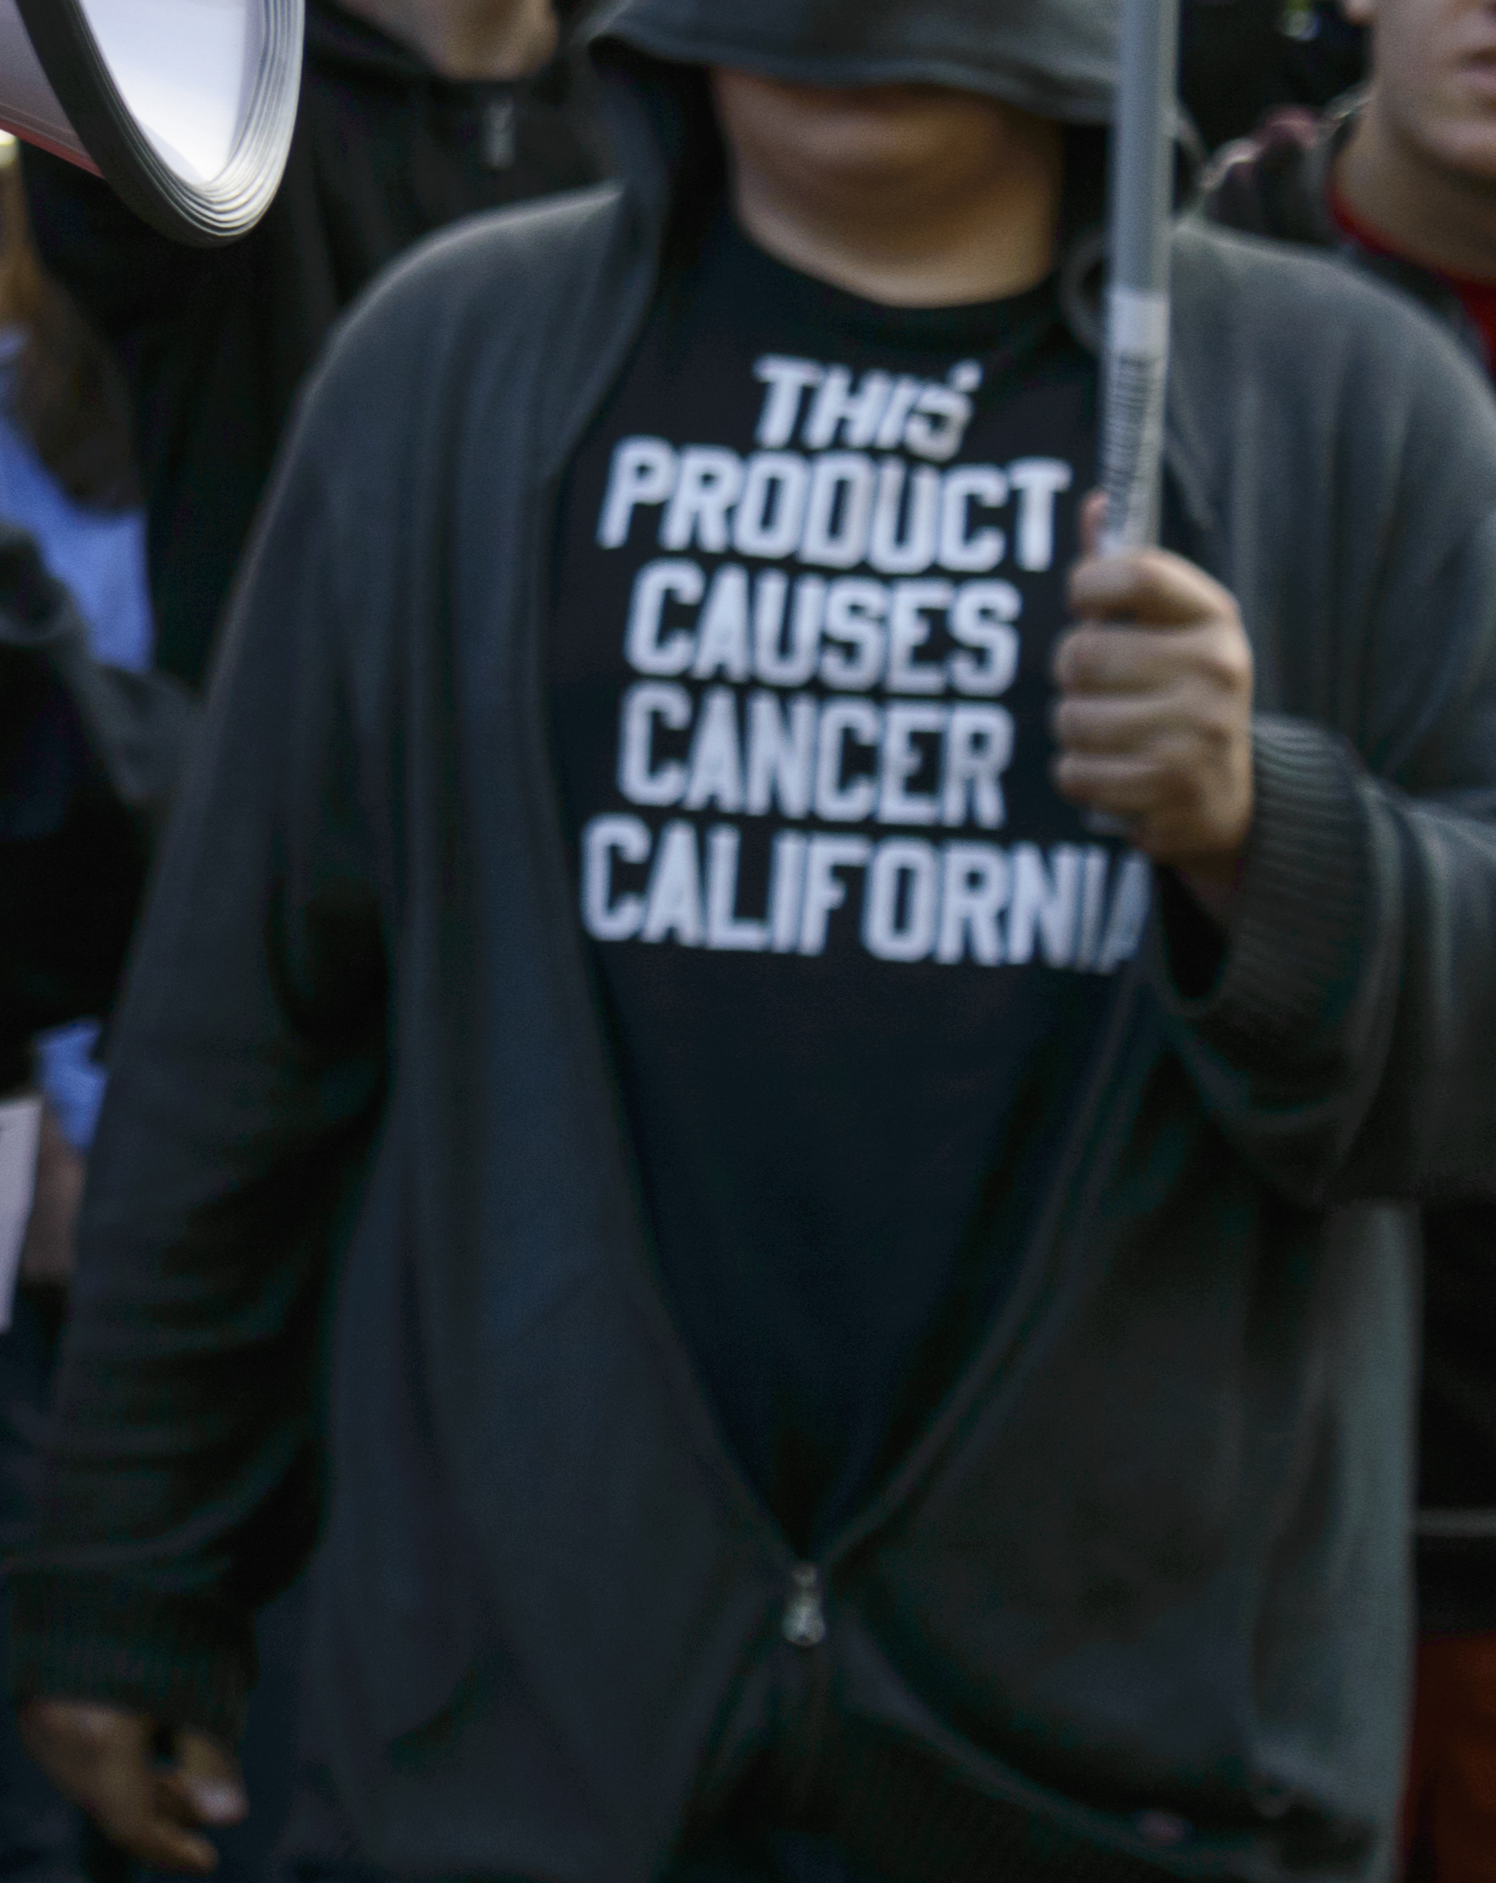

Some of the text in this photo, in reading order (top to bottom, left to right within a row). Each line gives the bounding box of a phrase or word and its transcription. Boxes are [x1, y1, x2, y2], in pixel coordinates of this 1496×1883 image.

[753, 354, 981, 461] THIS
[598, 434, 1072, 574] PRODUCT
[625, 559, 1020, 698] CAUSES
[617, 680, 1014, 829] CANCER
[581, 813, 1155, 976] CALIFORNIA
